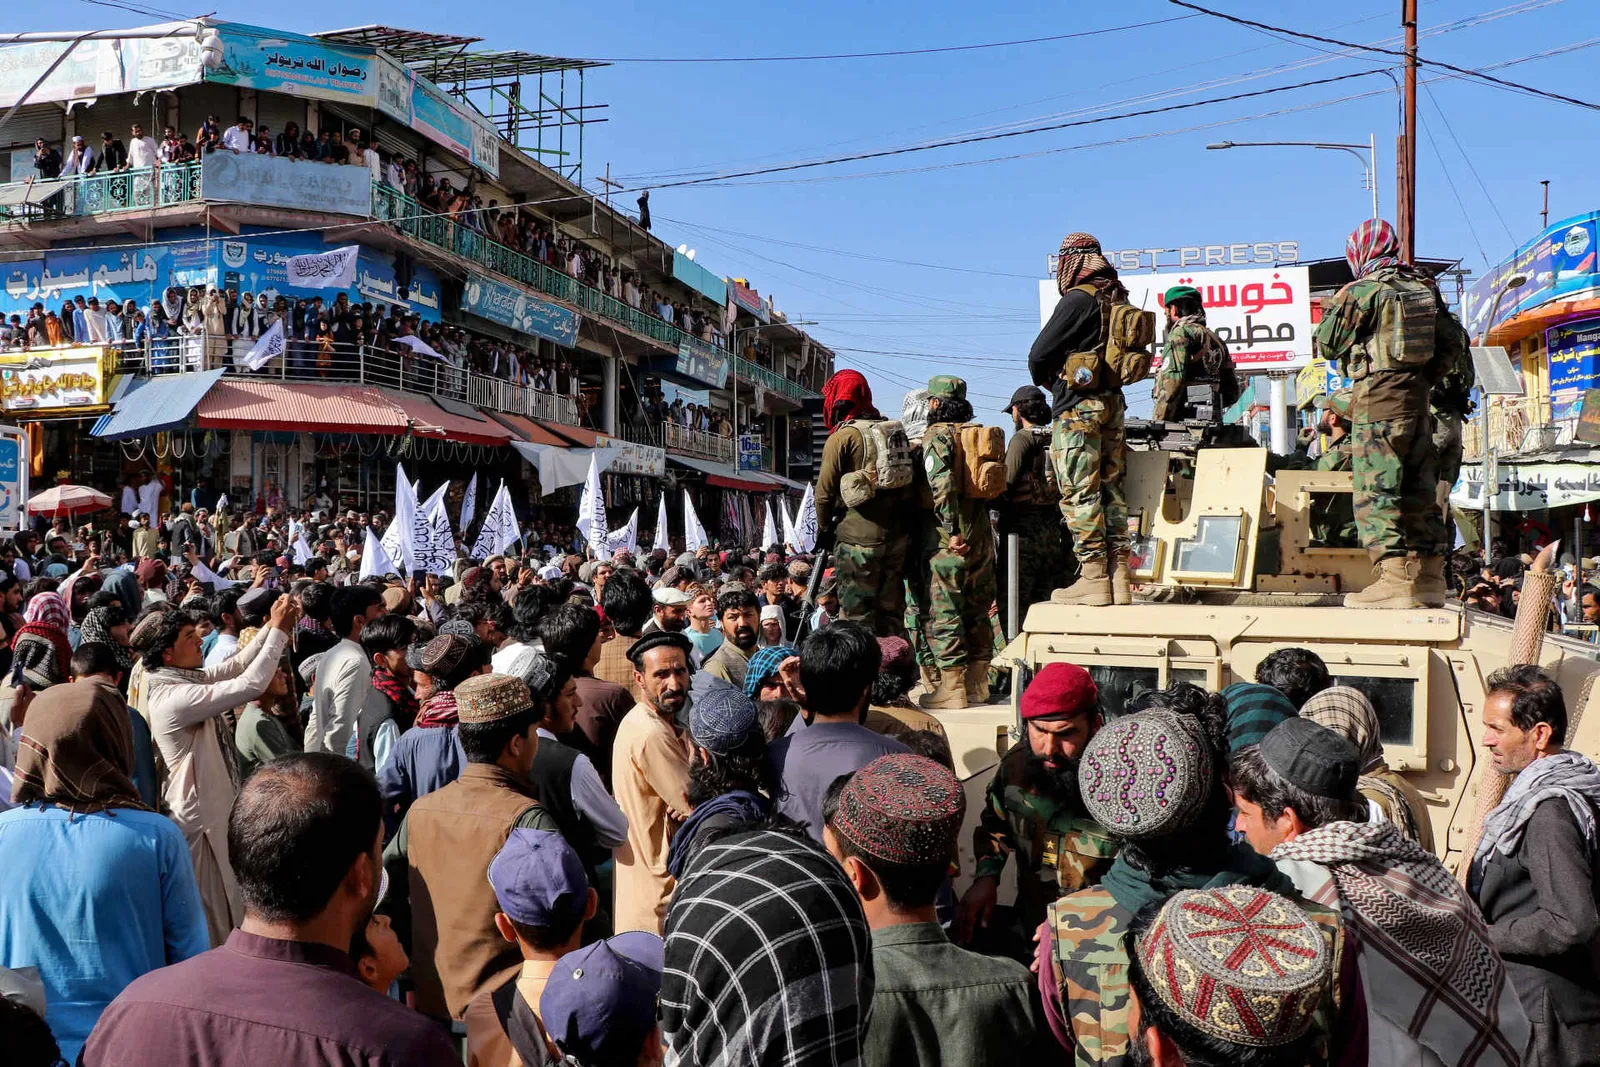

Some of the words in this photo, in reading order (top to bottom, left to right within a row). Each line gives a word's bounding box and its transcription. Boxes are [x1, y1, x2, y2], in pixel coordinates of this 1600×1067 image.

[306, 57, 325, 71] الله
[328, 61, 367, 81] رضوان
[1180, 241, 1298, 267] PRESS
[92, 251, 158, 297] هاشم
[1214, 315, 1295, 351] مطبع
